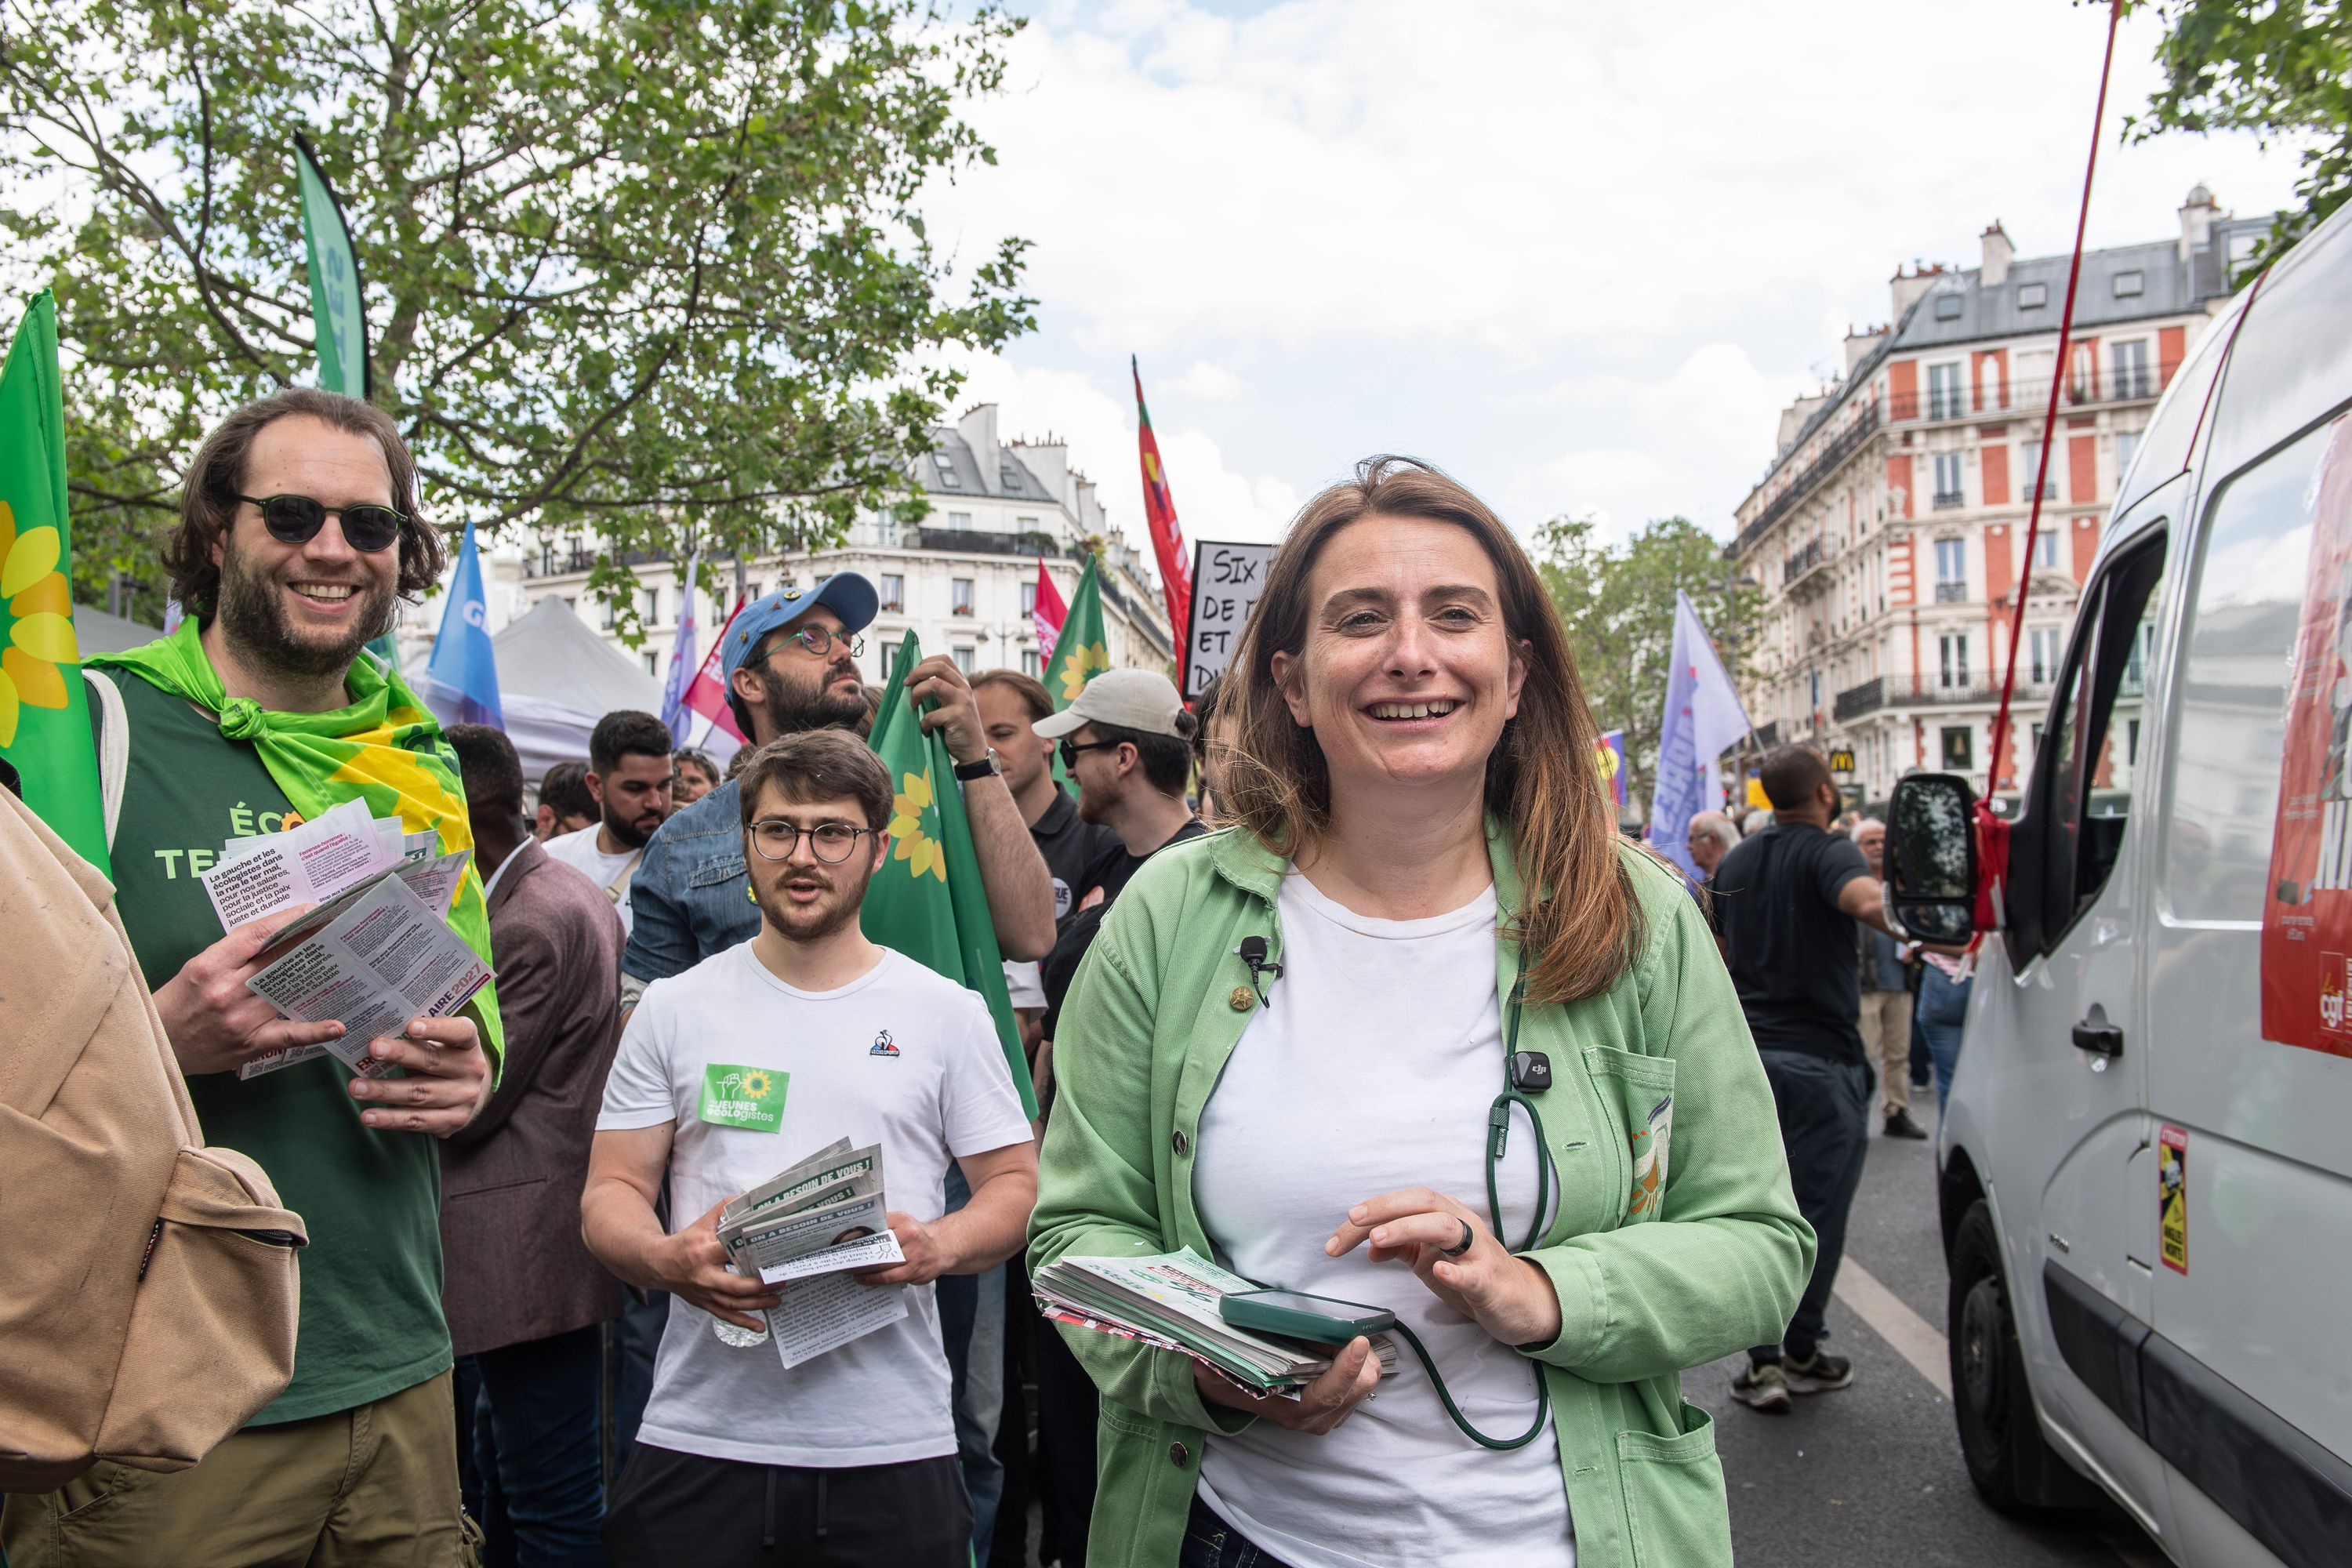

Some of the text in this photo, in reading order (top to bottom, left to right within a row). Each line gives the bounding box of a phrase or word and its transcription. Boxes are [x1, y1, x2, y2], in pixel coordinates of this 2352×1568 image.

[1213, 550, 1258, 585] SIX
[1202, 597, 1236, 622] DE
[1199, 631, 1231, 655] ET
[297, 832, 344, 858] Femmes-hommes
[299, 835, 350, 862] c'est quand l'égalité
[154, 849, 227, 880] TE
[209, 848, 276, 884] La gauche et les
[213, 854, 283, 890] écologistes dans
[225, 883, 241, 894] rue
[249, 872, 262, 882] 1er
[263, 863, 281, 876] mai,
[219, 869, 290, 906] pour nos salaires,
[222, 898, 241, 913] pour
[251, 882, 279, 899] justice
[225, 902, 255, 919] sociale
[256, 896, 265, 905] et
[273, 884, 291, 897] paix
[228, 913, 249, 927] juste
[260, 893, 290, 911] durable
[253, 978, 265, 986] La
[265, 958, 294, 980] gauche
[302, 942, 317, 953] les
[260, 944, 325, 989] écologistes dans
[268, 953, 335, 997] pour nos salaires,
[272, 977, 287, 989] rue
[294, 963, 307, 973] 1er
[307, 952, 325, 965] mai,
[448, 961, 485, 996] 2027
[273, 987, 291, 1001] pour
[299, 965, 326, 985] justice
[278, 985, 306, 1004] sociale
[322, 963, 339, 977] paix
[281, 994, 302, 1009] juste
[310, 970, 340, 990] durable
[1532, 1064, 1547, 1075] dji
[717, 1100, 757, 1112] JEUNES
[749, 1203, 866, 1244] ON A BESOIN DE VOUS
